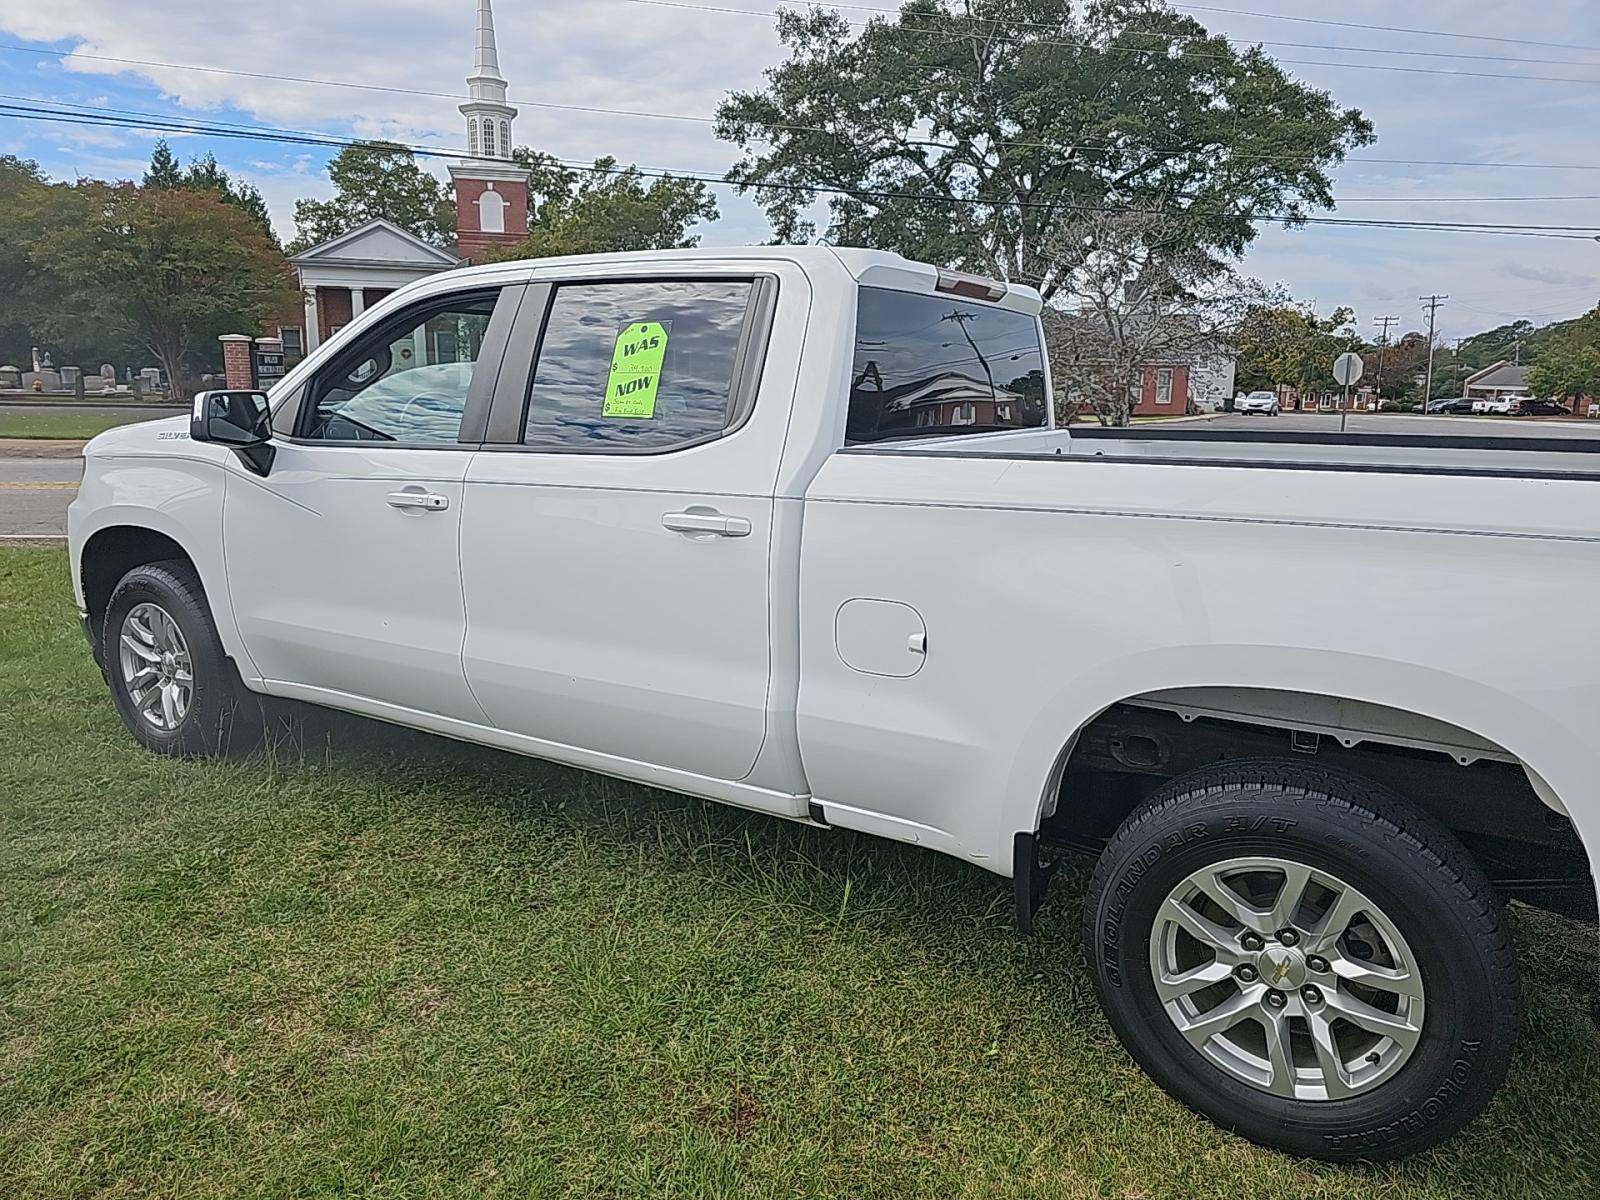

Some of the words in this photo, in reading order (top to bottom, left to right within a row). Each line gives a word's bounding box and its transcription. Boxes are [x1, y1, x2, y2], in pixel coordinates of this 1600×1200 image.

[623, 335, 660, 357] WAS
[612, 362, 618, 372] $
[615, 376, 653, 397] NOW
[1223, 814, 1299, 833] H/T
